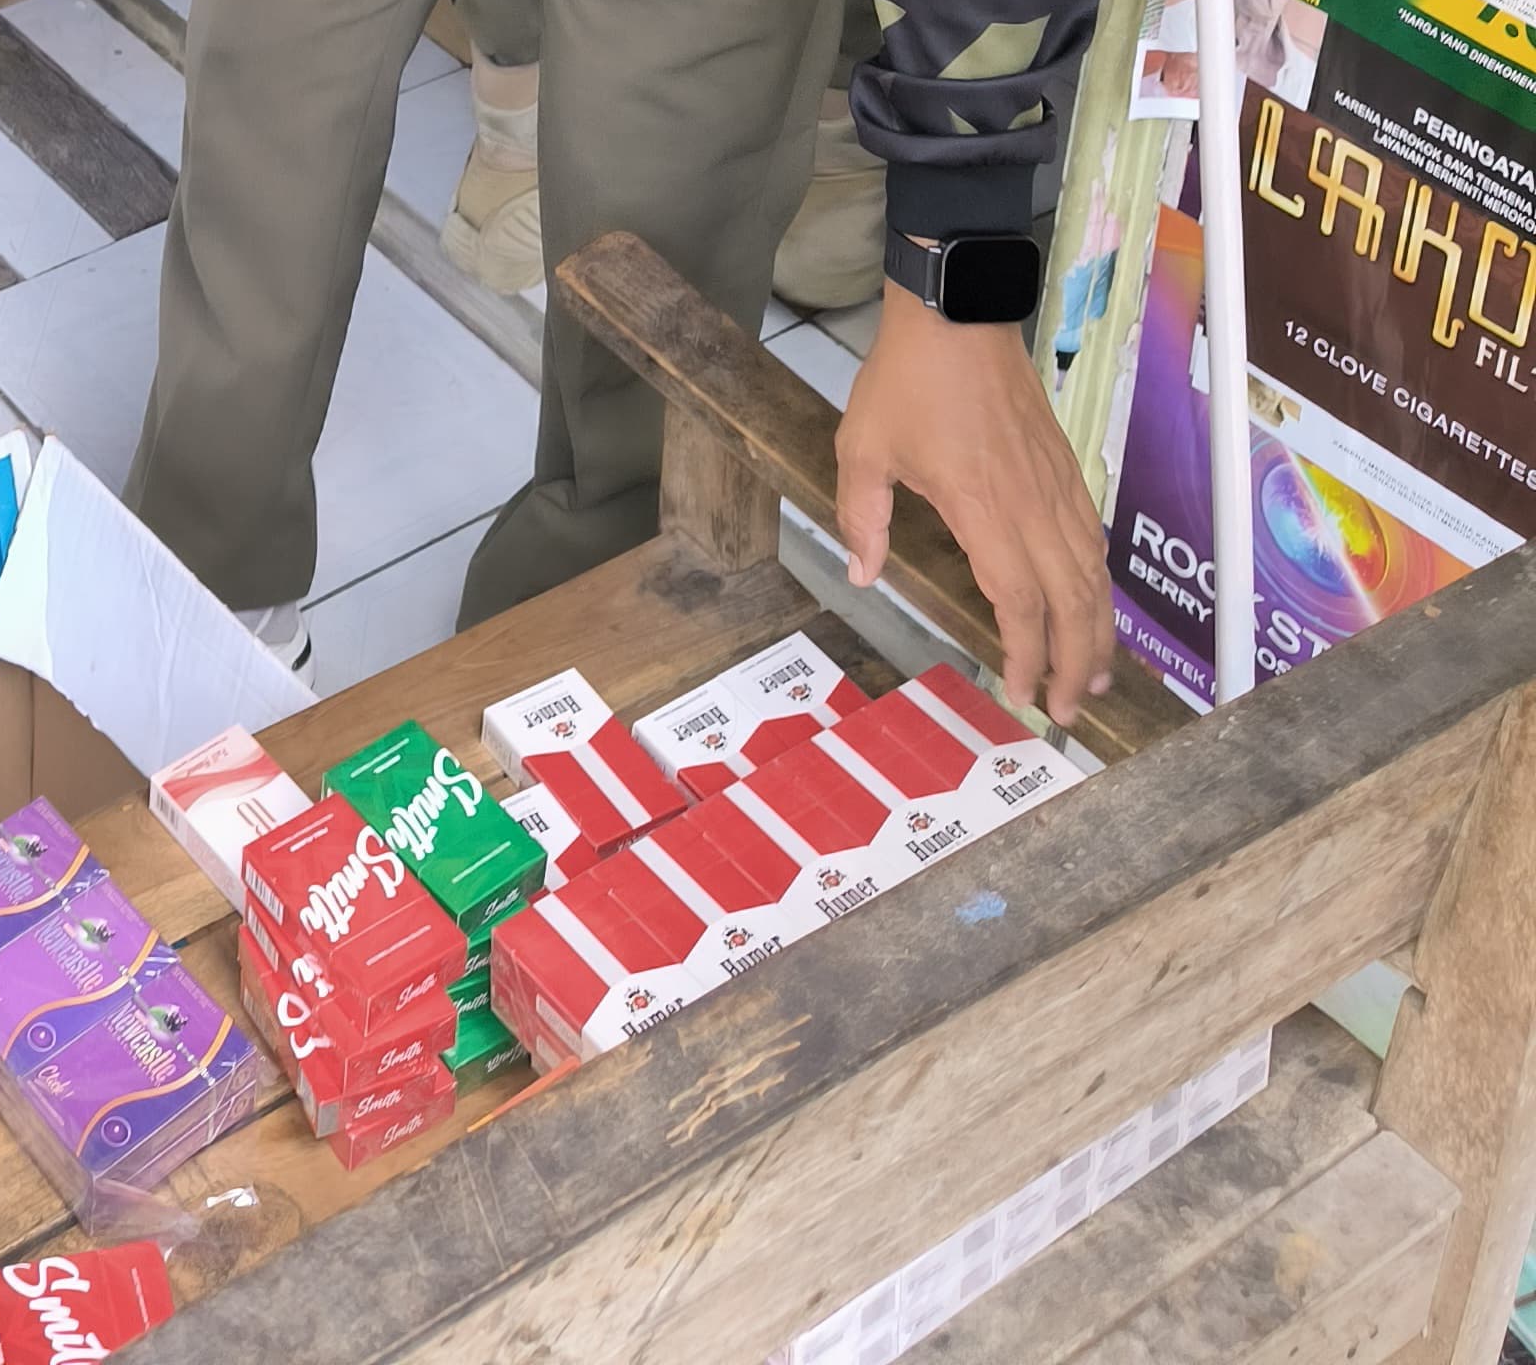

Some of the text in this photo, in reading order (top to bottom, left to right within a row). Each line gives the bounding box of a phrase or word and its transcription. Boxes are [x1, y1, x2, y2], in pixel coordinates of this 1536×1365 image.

[1439, 29, 1470, 58] YANG
[1334, 89, 1382, 129] KARENA
[1442, 151, 1476, 183] SAYA
[1475, 169, 1533, 218] TERKENA
[1372, 128, 1426, 169] LAYANAN
[1425, 158, 1482, 202] BERHENTI
[1284, 319, 1309, 348] 12
[1311, 336, 1389, 397] CLOVE
[1128, 552, 1215, 625] BERRY
[758, 657, 815, 694] Humer
[1136, 626, 1207, 690] KRETEK
[523, 694, 583, 729] Humer
[675, 705, 732, 743] Humer
[991, 763, 1056, 807] Humer
[905, 816, 970, 863] Humer
[815, 873, 881, 921] Humer
[36, 916, 107, 993] Newcastle
[719, 933, 785, 978] Humer
[396, 972, 438, 1012] Smith
[106, 1000, 179, 1085] Newcastle
[377, 1040, 425, 1075] Smith
[354, 1088, 404, 1119] Smith
[381, 1112, 424, 1150] Smith
